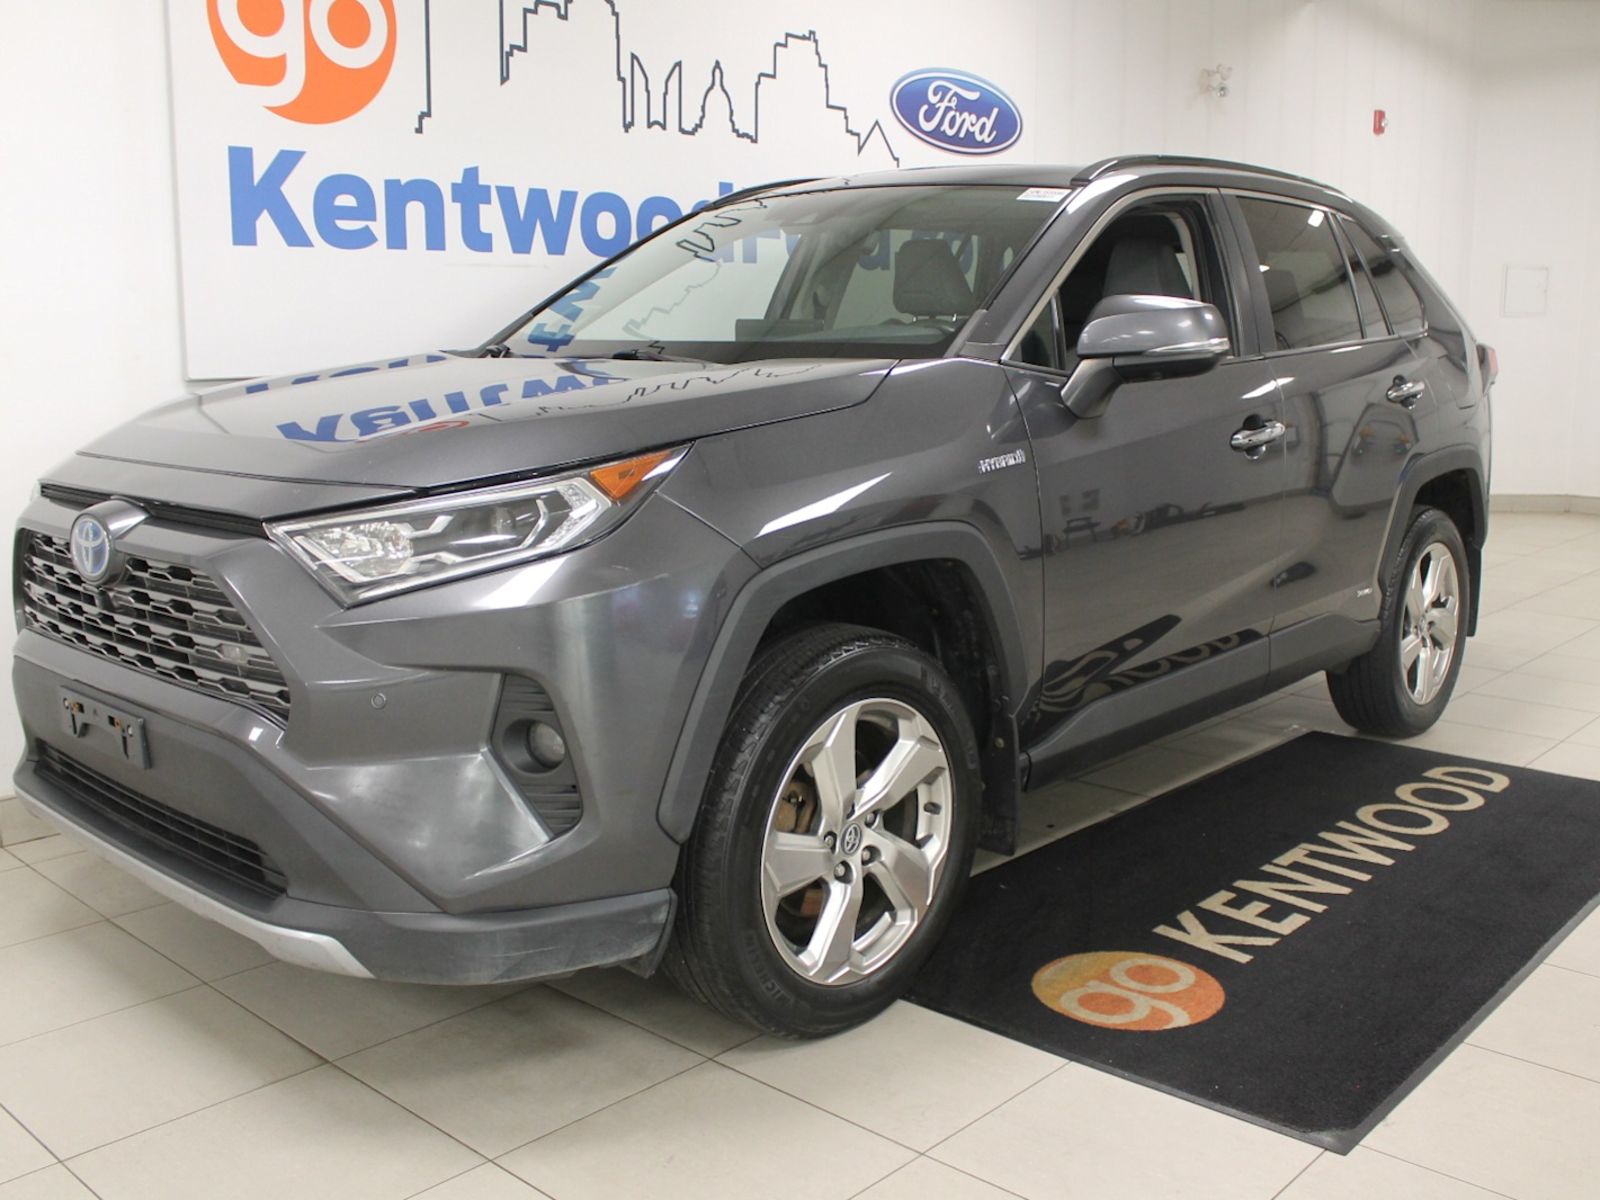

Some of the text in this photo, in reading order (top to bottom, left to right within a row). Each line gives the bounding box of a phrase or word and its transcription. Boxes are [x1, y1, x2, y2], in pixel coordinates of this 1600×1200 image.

[918, 80, 999, 143] Ford
[1152, 766, 1511, 963] KENTWOOD
[1059, 957, 1197, 1029] go
